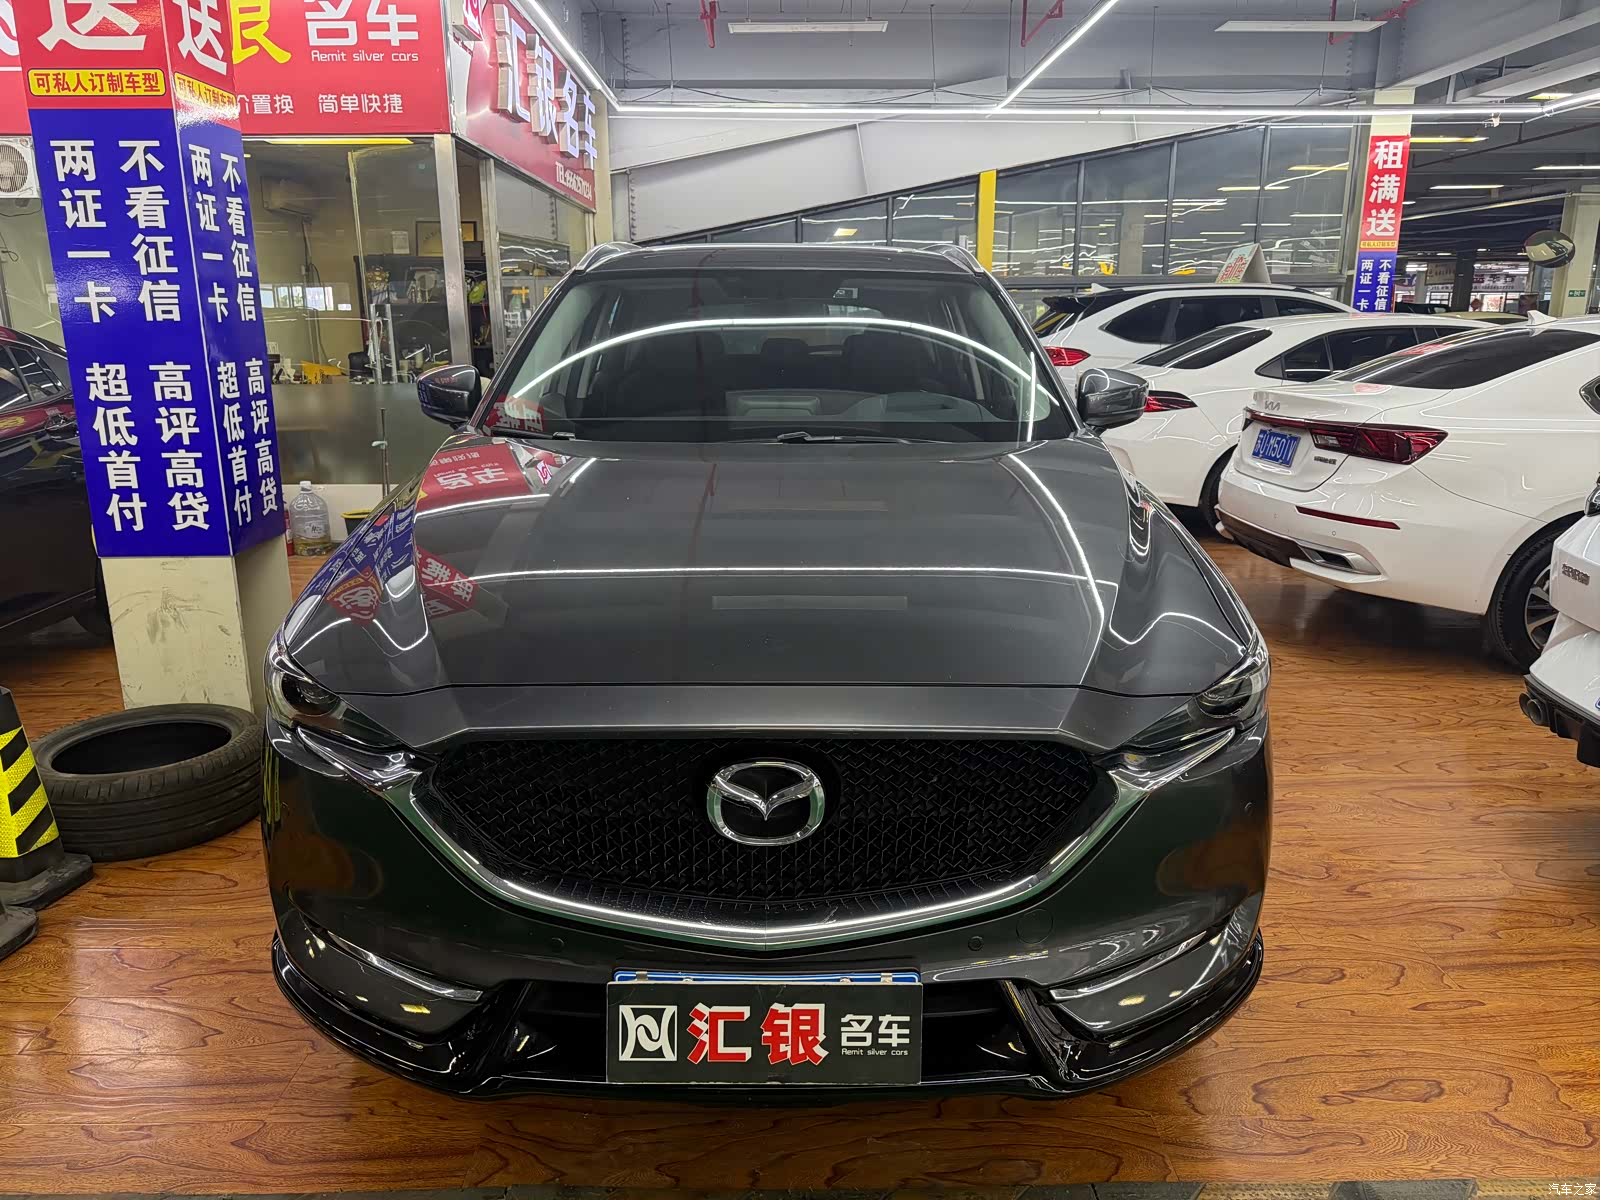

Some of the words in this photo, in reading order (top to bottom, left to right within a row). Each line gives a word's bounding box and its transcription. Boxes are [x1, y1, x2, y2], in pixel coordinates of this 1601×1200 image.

[304, 0, 419, 46] 名车
[352, 50, 385, 62] silver
[391, 53, 419, 62] cars
[33, 71, 161, 93] 可私人订制车型
[318, 93, 403, 114] 简单快捷
[50, 140, 117, 323] 两证一卡
[119, 140, 181, 322] 不看征信
[188, 144, 229, 323] 两证一卡
[220, 152, 257, 322] 不看征信
[1366, 140, 1403, 237] 租满送
[1356, 259, 1374, 311] 两证一卡
[1374, 259, 1392, 311] 不看征信
[86, 362, 147, 531] 超低首付
[149, 361, 210, 530] 高评高贷
[217, 361, 252, 526] 超低首付
[245, 358, 278, 516] 高评高贷
[686, 1002, 829, 1066] 汇银
[840, 1013, 911, 1047] 名车
[867, 1047, 888, 1056] silver
[890, 1048, 909, 1056] cars
